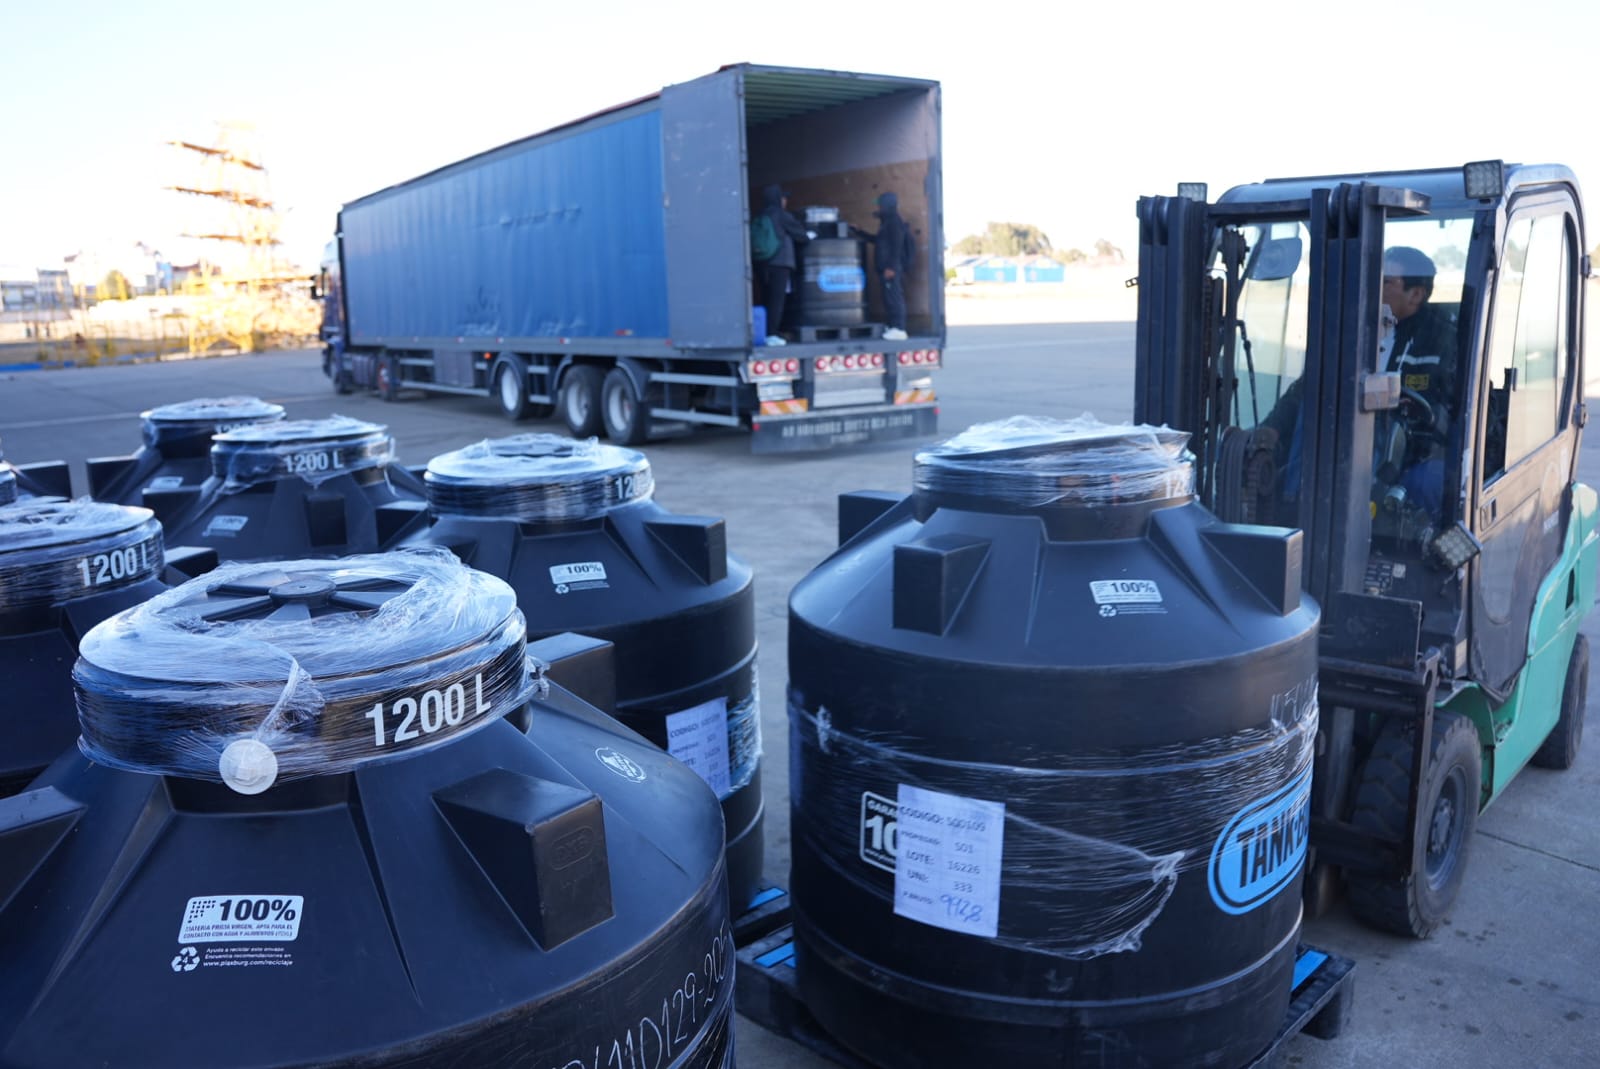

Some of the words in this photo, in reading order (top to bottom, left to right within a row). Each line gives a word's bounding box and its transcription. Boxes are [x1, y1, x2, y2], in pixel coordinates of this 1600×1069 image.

[283, 452, 329, 473] 1200
[333, 449, 345, 469] L
[77, 547, 138, 586] 1200
[141, 543, 152, 570] L
[567, 563, 602, 574] 100%
[1110, 582, 1156, 593] 100%
[365, 683, 465, 746] 1200
[475, 673, 492, 715] L
[219, 898, 296, 921] 100%
